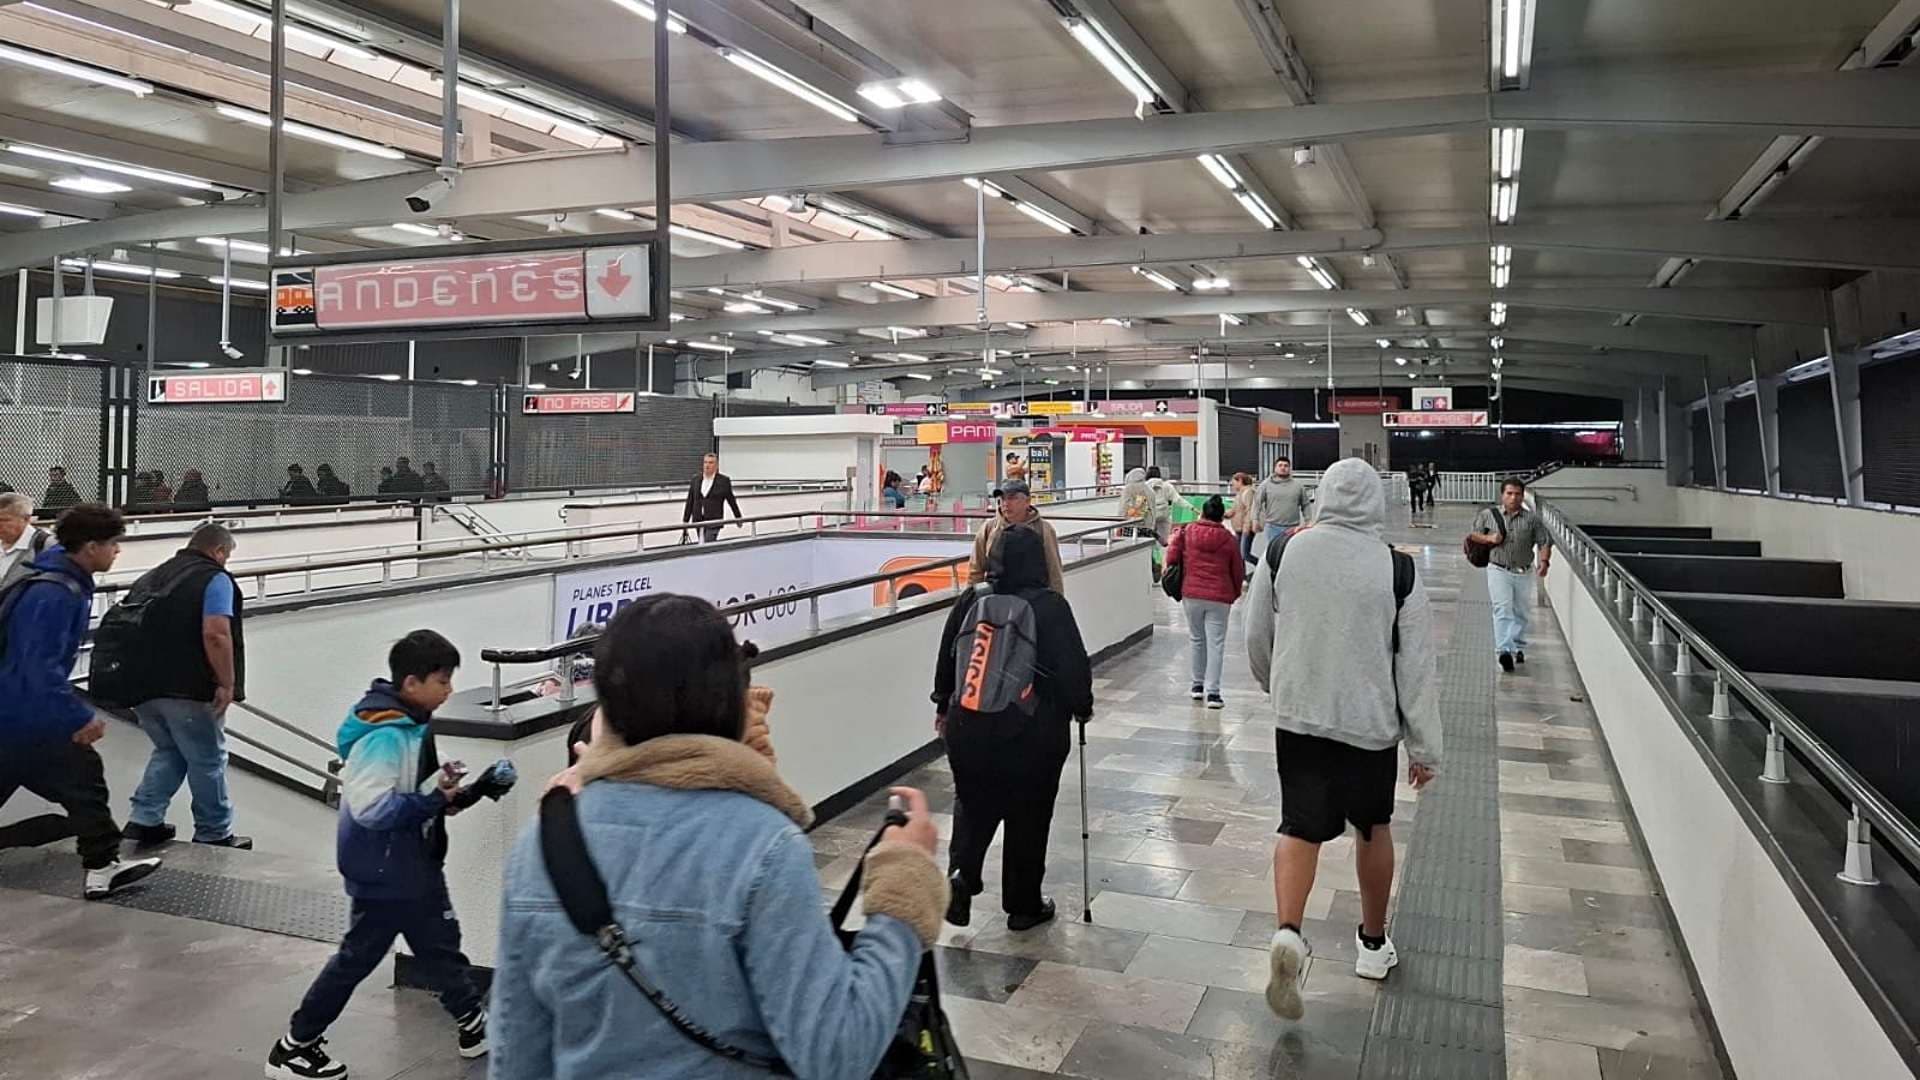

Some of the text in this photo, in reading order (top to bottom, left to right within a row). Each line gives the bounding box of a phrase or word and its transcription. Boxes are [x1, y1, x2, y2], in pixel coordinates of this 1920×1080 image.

[317, 267, 582, 312] ANDENES
[175, 379, 253, 397] SALIDA
[543, 396, 610, 409] NO PASE
[572, 576, 652, 601] PLANES TELCEL
